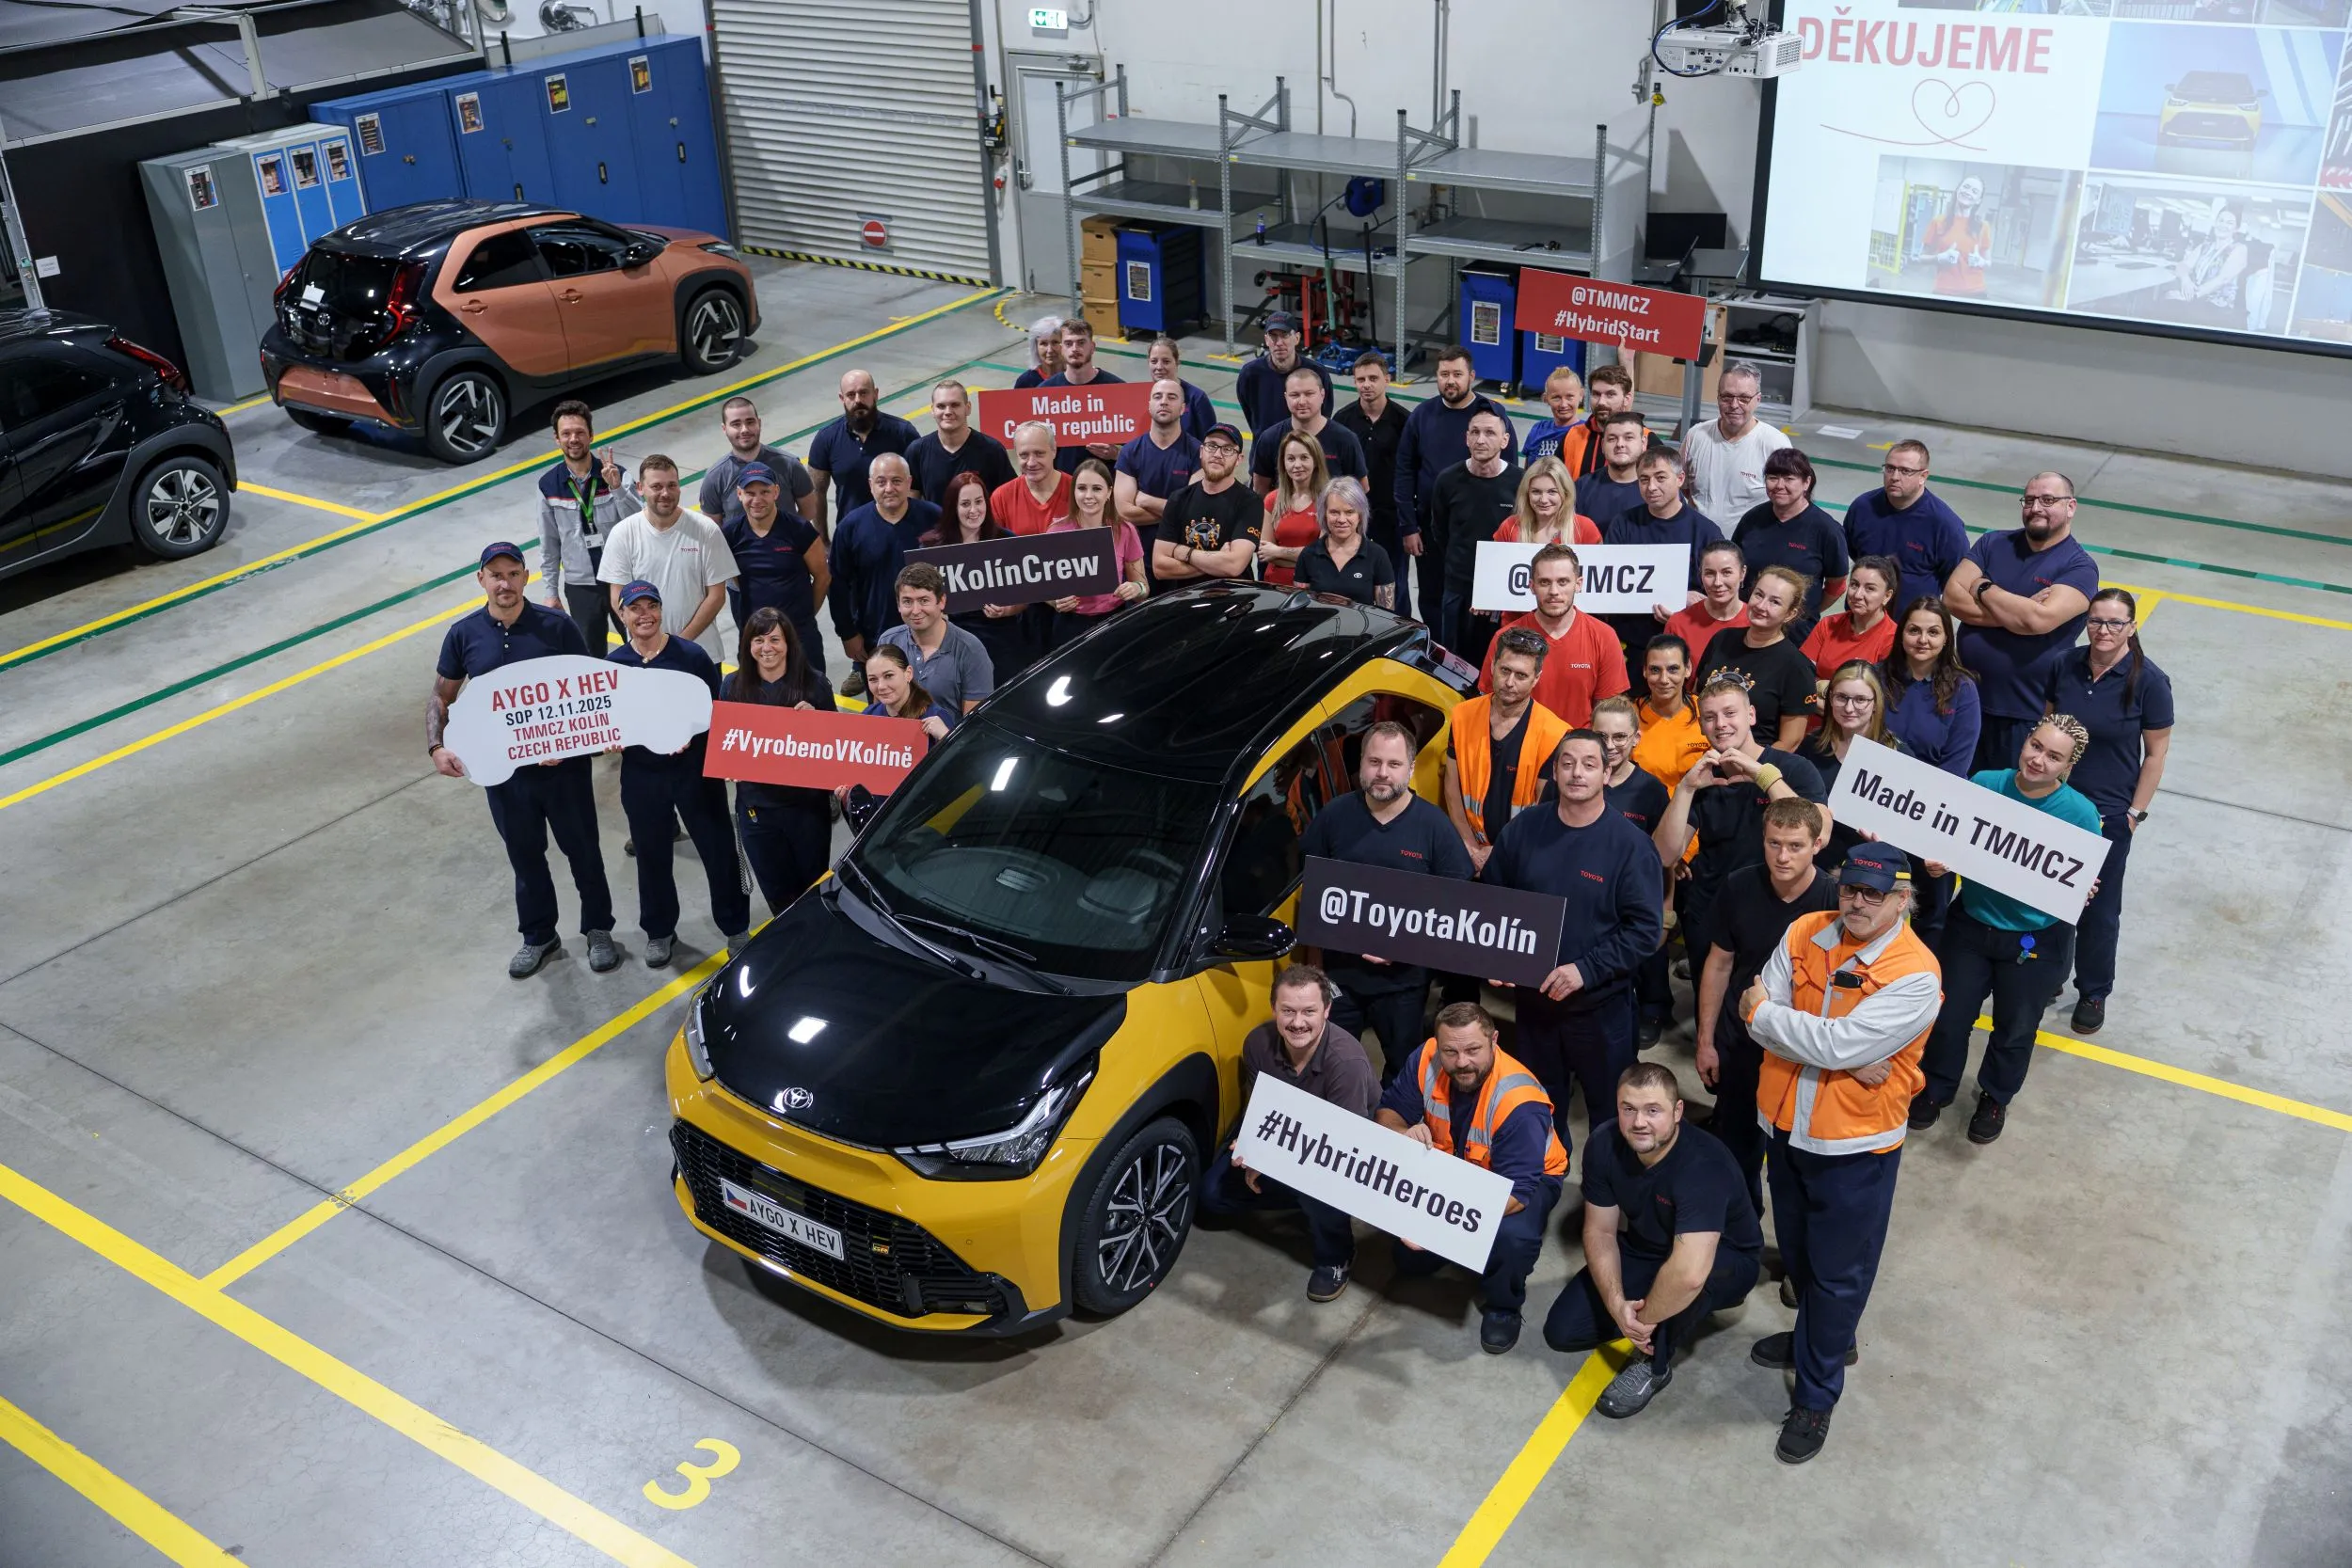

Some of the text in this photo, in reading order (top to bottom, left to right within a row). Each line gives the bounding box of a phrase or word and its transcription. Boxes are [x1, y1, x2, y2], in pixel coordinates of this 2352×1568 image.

[1798, 6, 2053, 74] DĚKUJEME
[1571, 286, 1651, 314] @TMMCZ
[1554, 309, 1661, 342] #HybridStart
[1031, 393, 1104, 415] Made in
[1062, 414, 1136, 438] republic
[1508, 563, 1655, 596] @MCZ
[492, 669, 619, 711] AYGO X HEV
[505, 695, 612, 726] SOP 12.11.2025
[513, 711, 610, 742] TMMCZ KOLÍN
[508, 728, 622, 761] CZECH REPUBLIC
[722, 728, 913, 768] #VyrobenoVKolíně
[1623, 811, 1645, 821] TOYOTA
[1851, 768, 2085, 888] Made in TMMCZ
[1400, 848, 1423, 860] TOYOTA
[1853, 858, 1883, 870] TOYOTA
[1581, 870, 1604, 883] TOYOTA
[1320, 886, 1537, 955] @ToyotaKolín
[1256, 1109, 1483, 1233] #HybridHeroes
[750, 1198, 835, 1251] AYGO X HEV
[643, 1437, 741, 1511] 3
